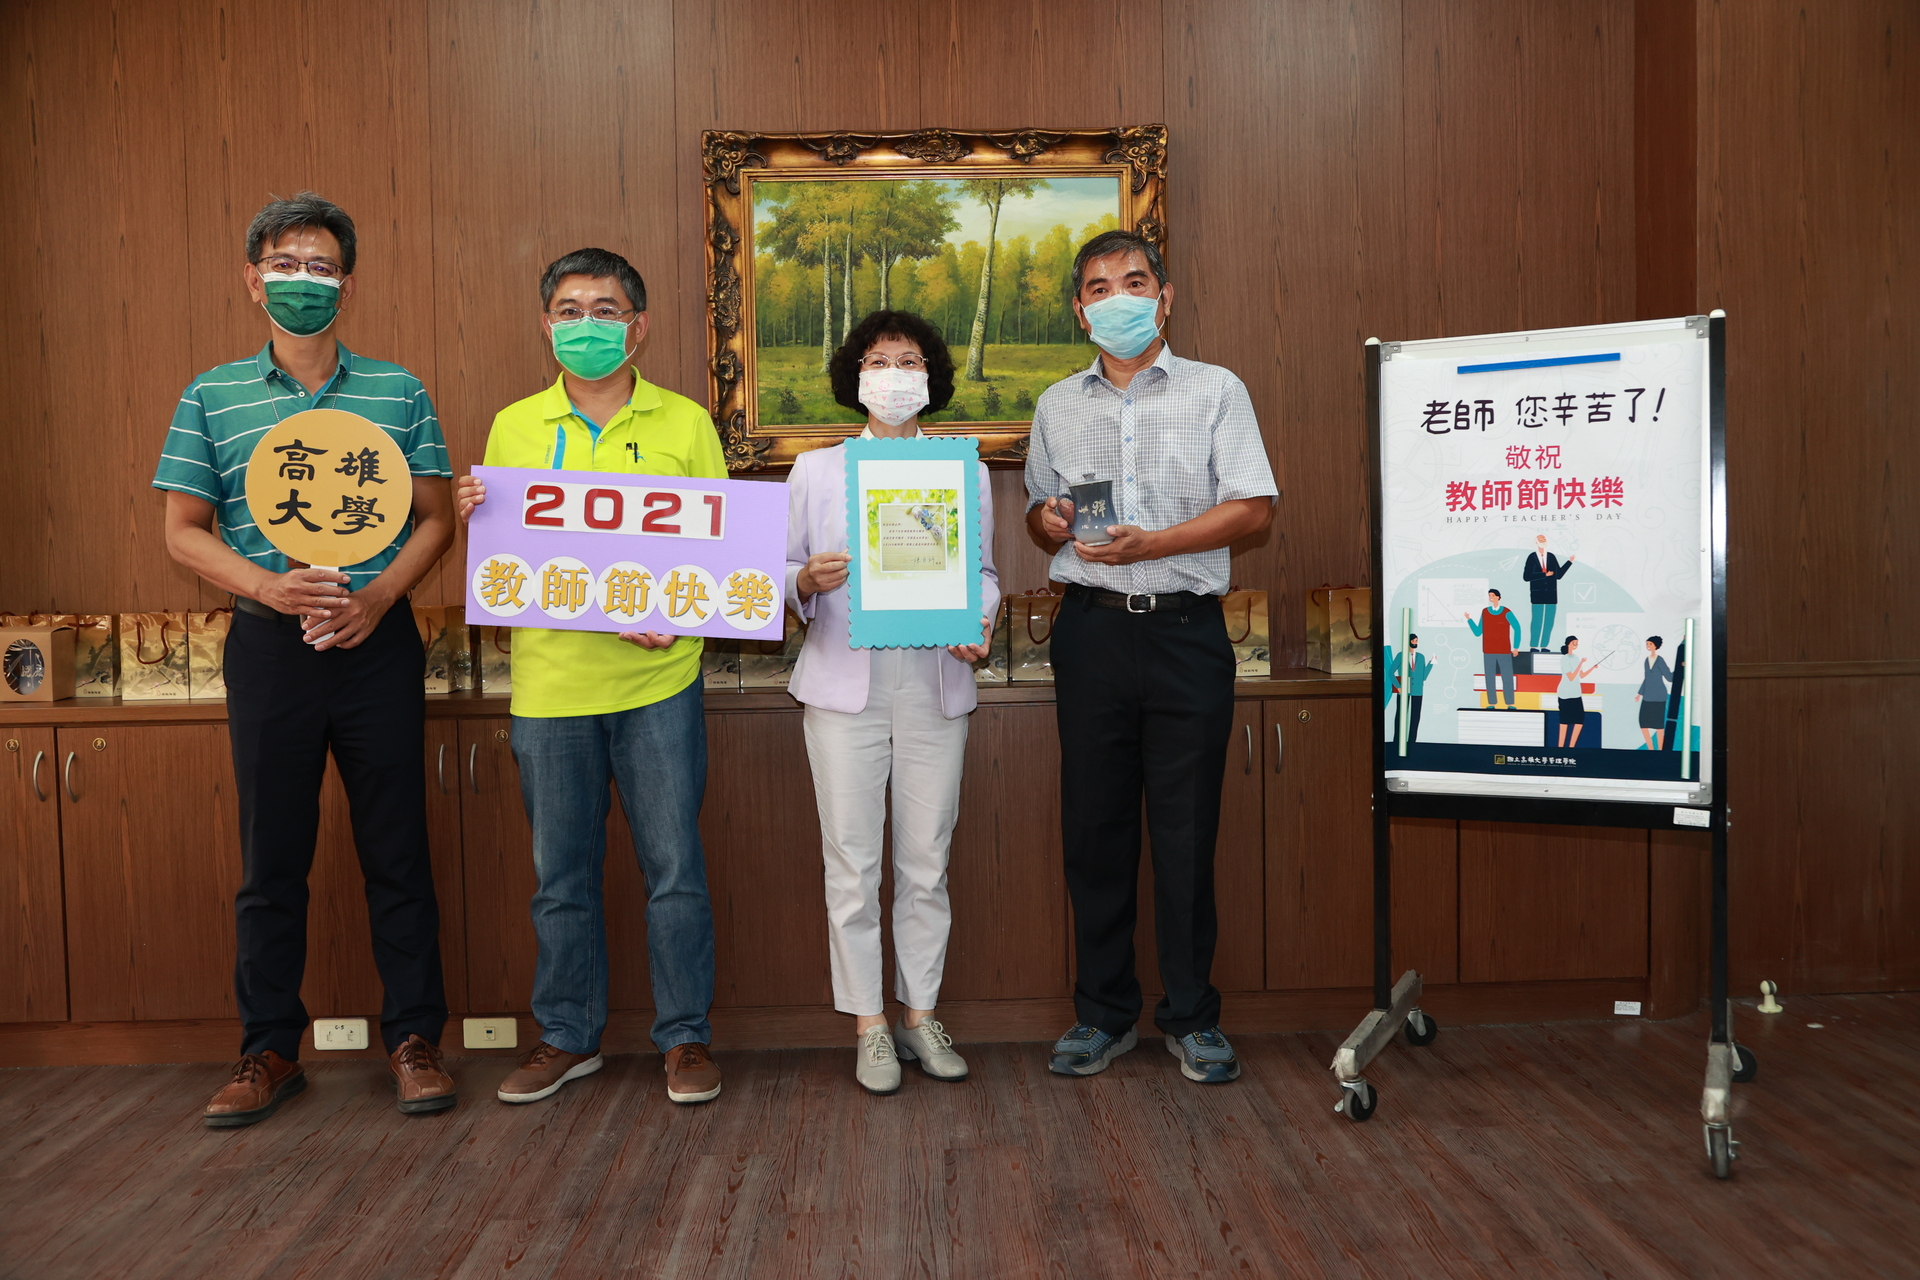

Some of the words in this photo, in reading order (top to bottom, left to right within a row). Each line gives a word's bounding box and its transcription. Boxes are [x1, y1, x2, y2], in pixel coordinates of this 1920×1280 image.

[1420, 400, 1495, 434] 老師
[273, 439, 388, 487] 高雄
[1505, 445, 1562, 470] 敬祝
[269, 488, 385, 535] 大學
[525, 485, 722, 536] 2021
[1445, 476, 1624, 512] 教師節快樂
[1446, 515, 1489, 524] HAPPY
[1503, 513, 1581, 522] TEACHER'S
[1596, 512, 1623, 521] DAY
[480, 559, 772, 620] 教師節快樂
